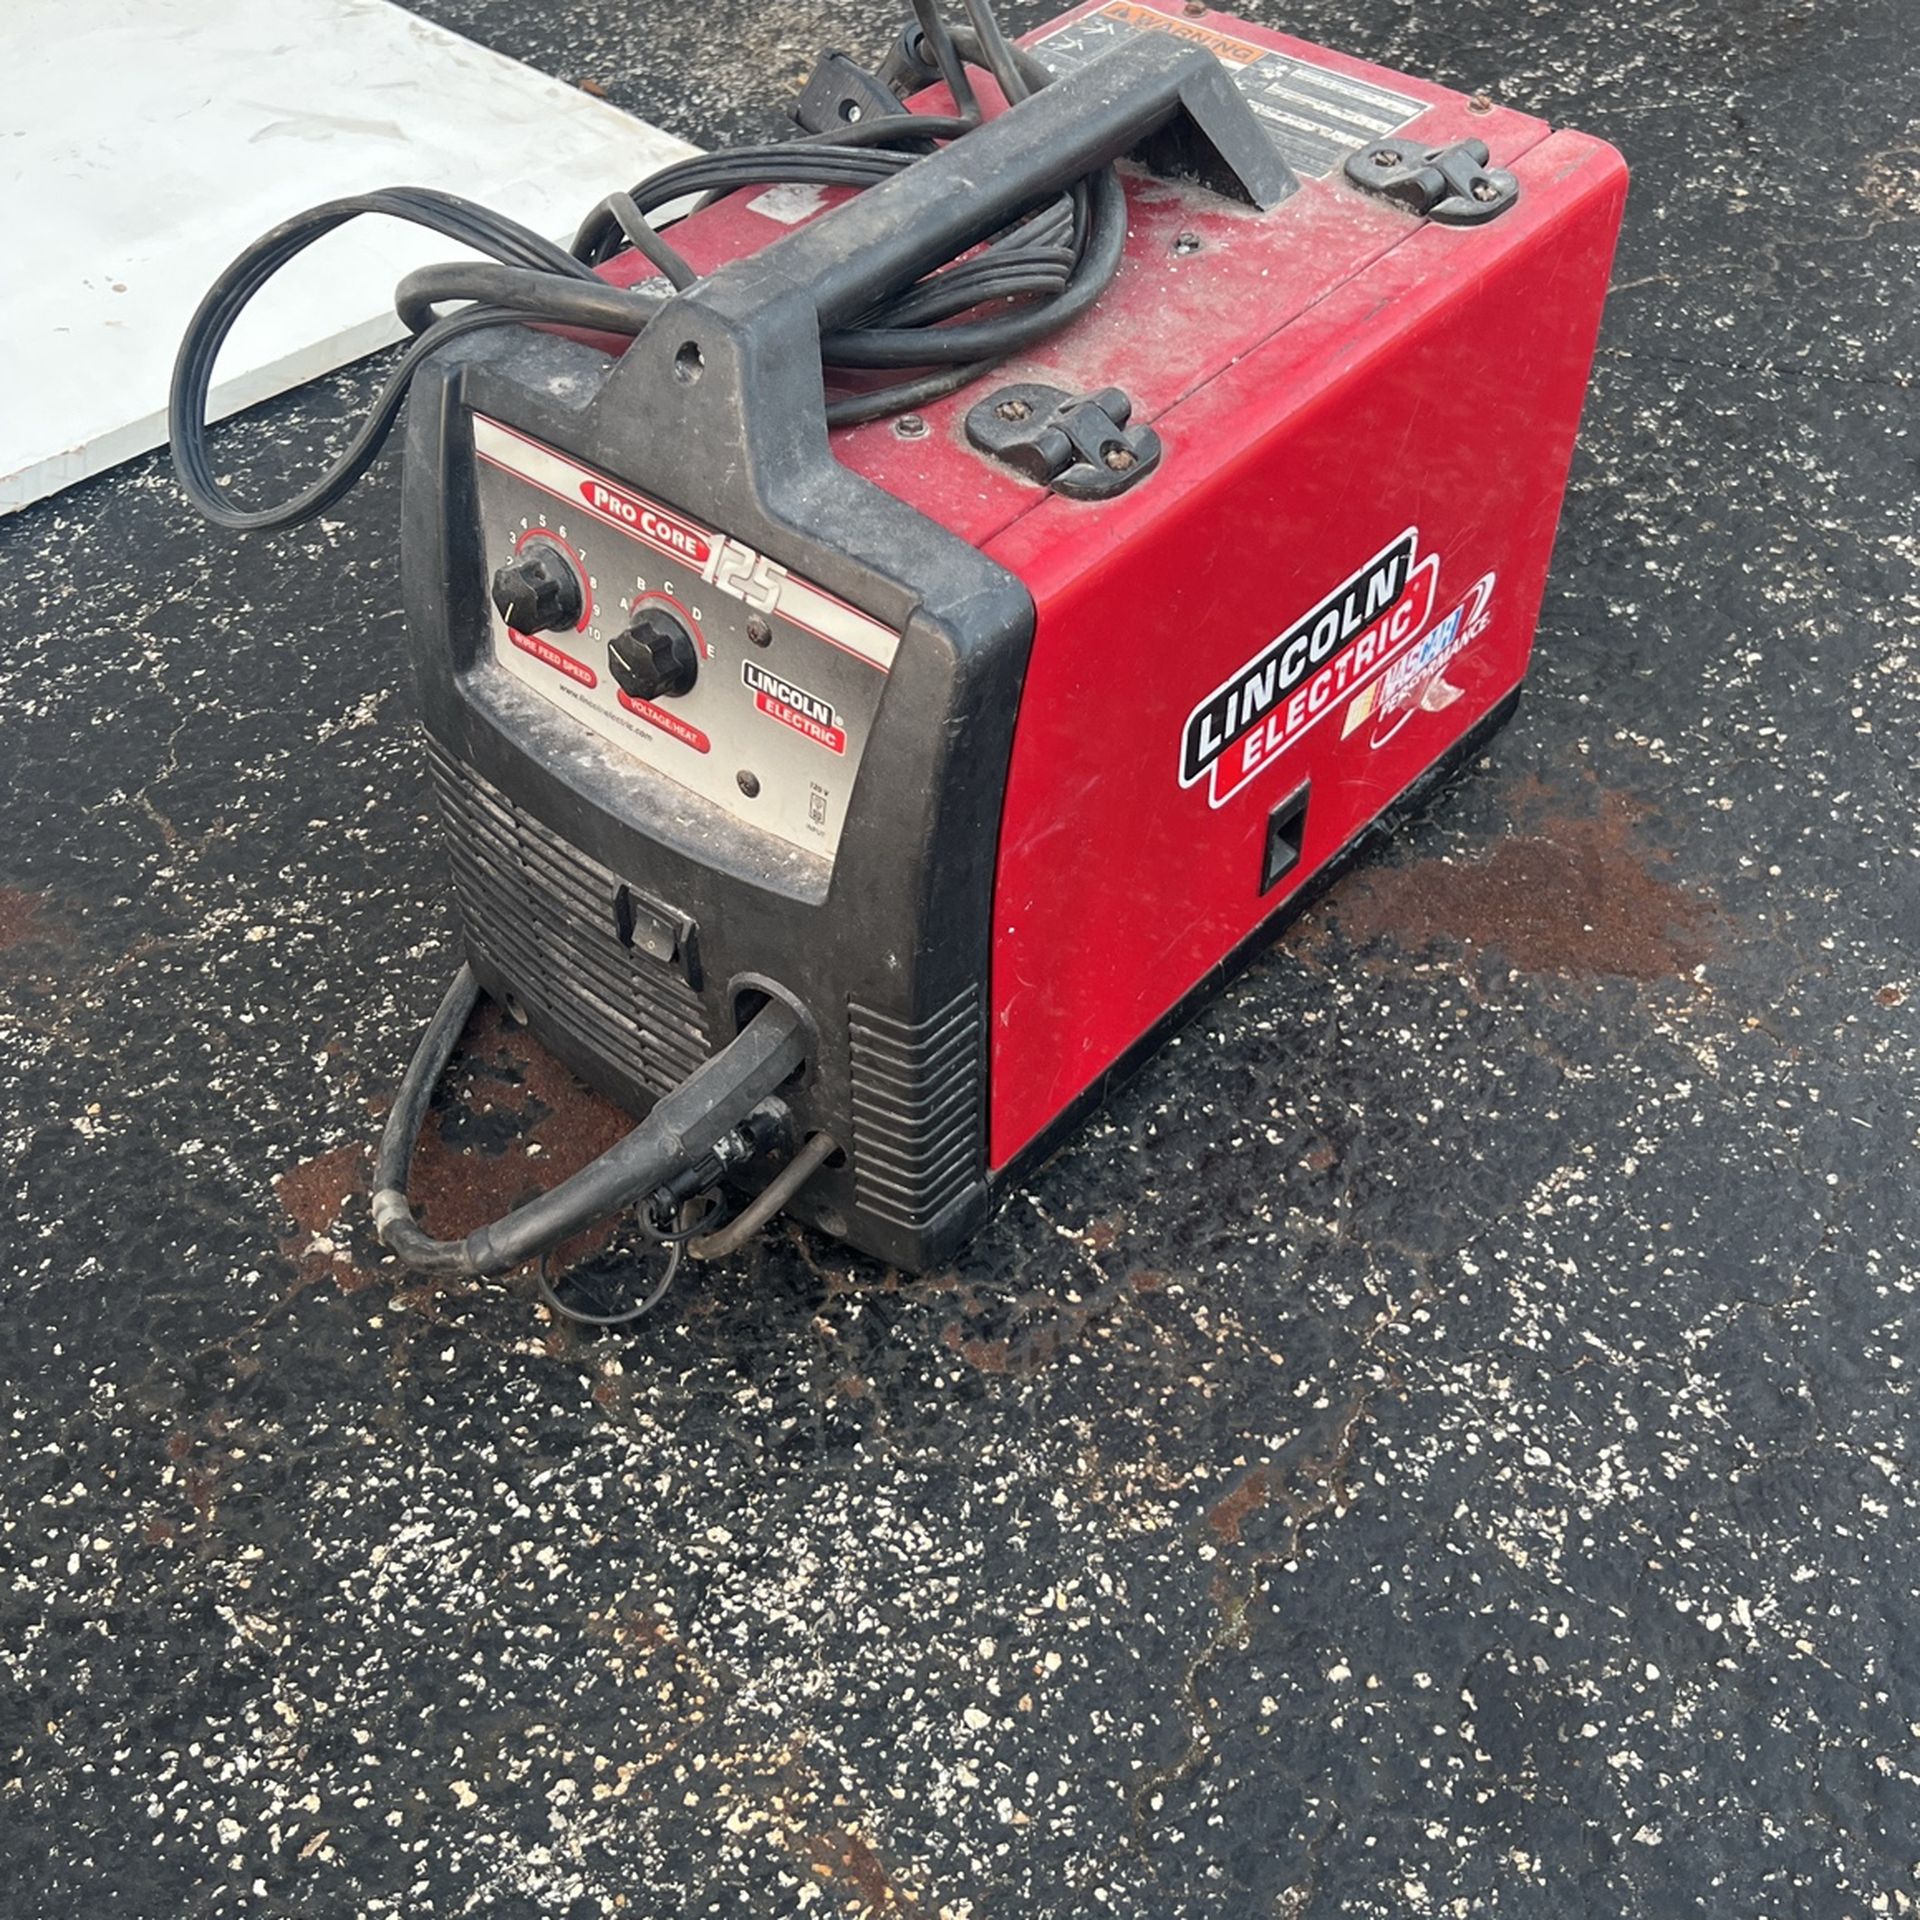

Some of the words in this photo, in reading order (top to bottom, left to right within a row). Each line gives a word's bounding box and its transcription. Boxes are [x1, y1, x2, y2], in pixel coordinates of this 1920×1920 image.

[520, 516, 528, 528] 4
[538, 515, 547, 527] 5
[509, 531, 517, 544] 3
[558, 525, 567, 538] 6
[578, 549, 586, 561] 7
[592, 485, 637, 522] PRO
[640, 511, 699, 556] CORE
[701, 533, 788, 614] 125
[589, 576, 597, 589] 8
[637, 577, 646, 590] B
[664, 582, 674, 595] C
[592, 604, 600, 616] 9
[620, 597, 629, 611] A
[692, 607, 702, 621] D
[588, 627, 601, 641] 10
[515, 630, 537, 652] WIRE
[538, 643, 561, 666] FEED
[562, 656, 592, 683] SPEED
[706, 644, 716, 658] E
[1198, 555, 1399, 761] LINCOLN
[1378, 611, 1491, 723] PEORMANCE
[1241, 598, 1413, 772] ELECTRIC
[747, 665, 830, 725] LINCOLN
[630, 698, 697, 742] VOLTAGE/HEAT
[765, 698, 837, 747] ELECTRIC
